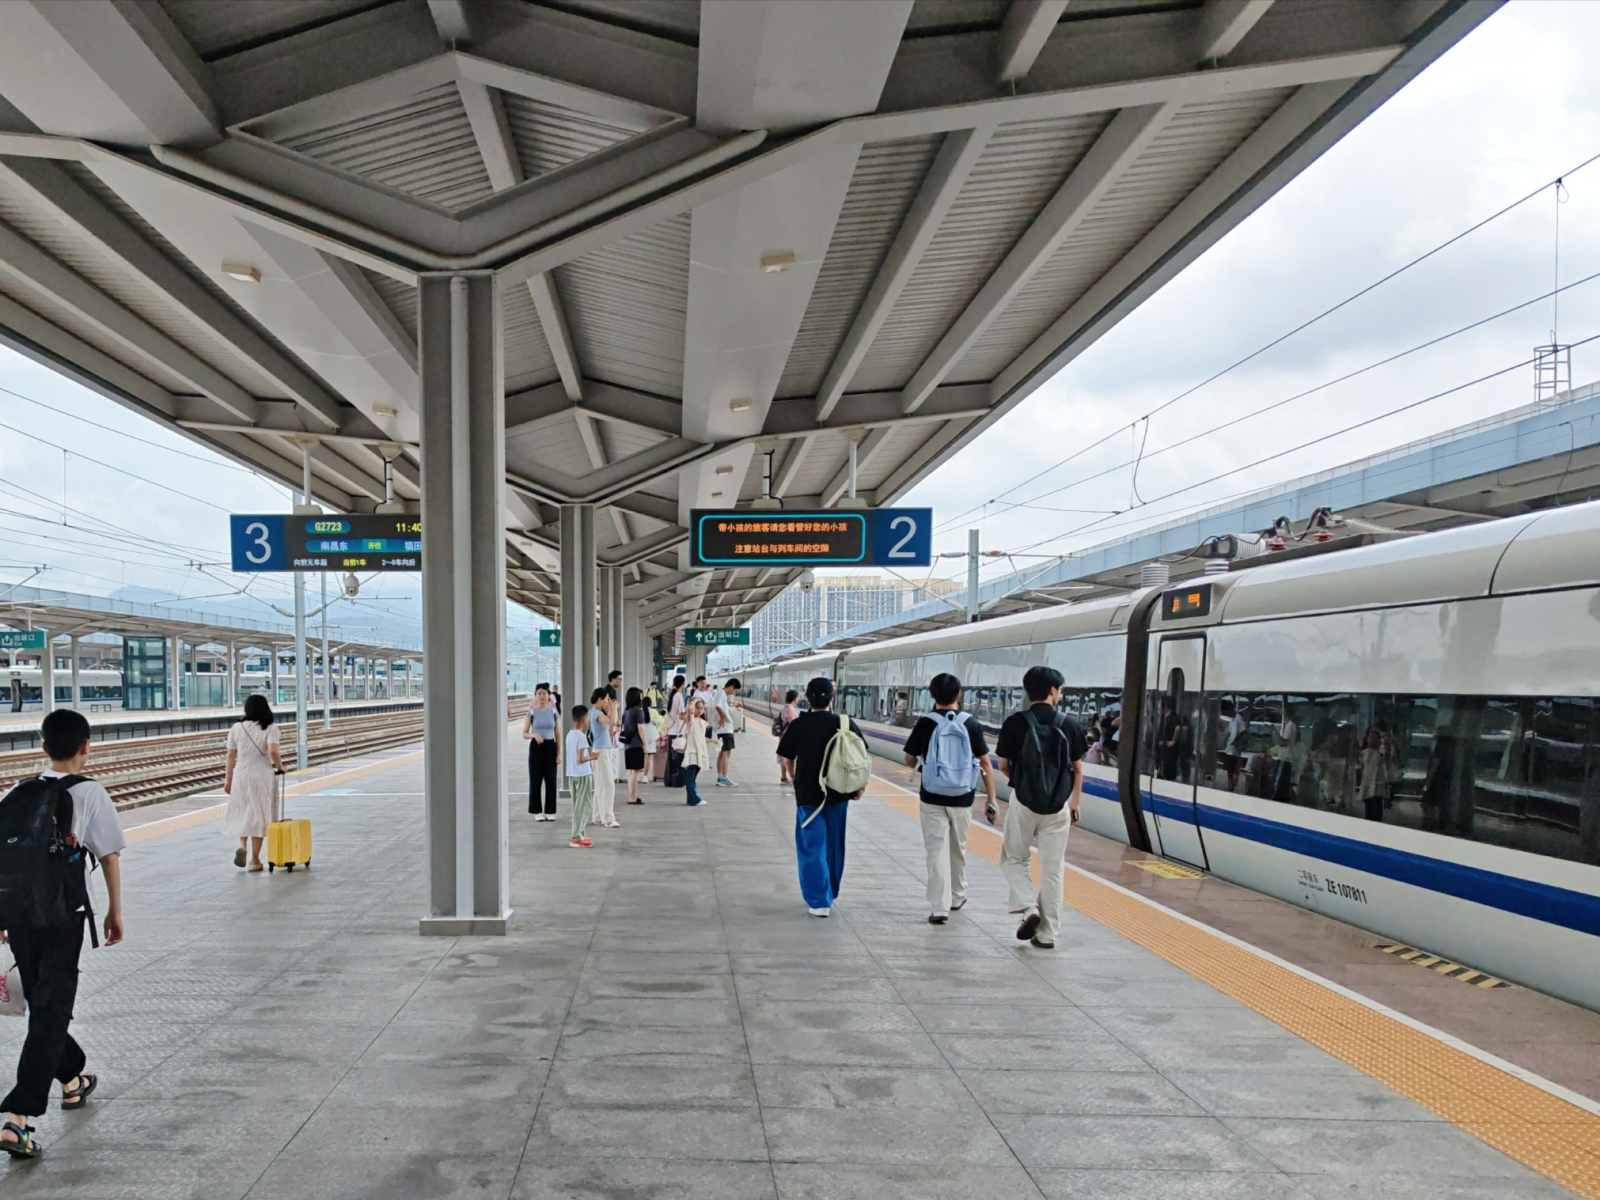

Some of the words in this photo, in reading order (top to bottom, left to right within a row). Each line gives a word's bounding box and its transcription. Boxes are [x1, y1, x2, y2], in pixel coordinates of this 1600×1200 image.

[315, 522, 342, 531] G2723
[888, 516, 917, 558] 2
[245, 522, 272, 563] 3
[320, 541, 348, 551] 南昌东
[368, 542, 382, 550] 开往
[404, 541, 421, 551] 福田
[735, 544, 829, 553] 注意站台与列车间的空隙
